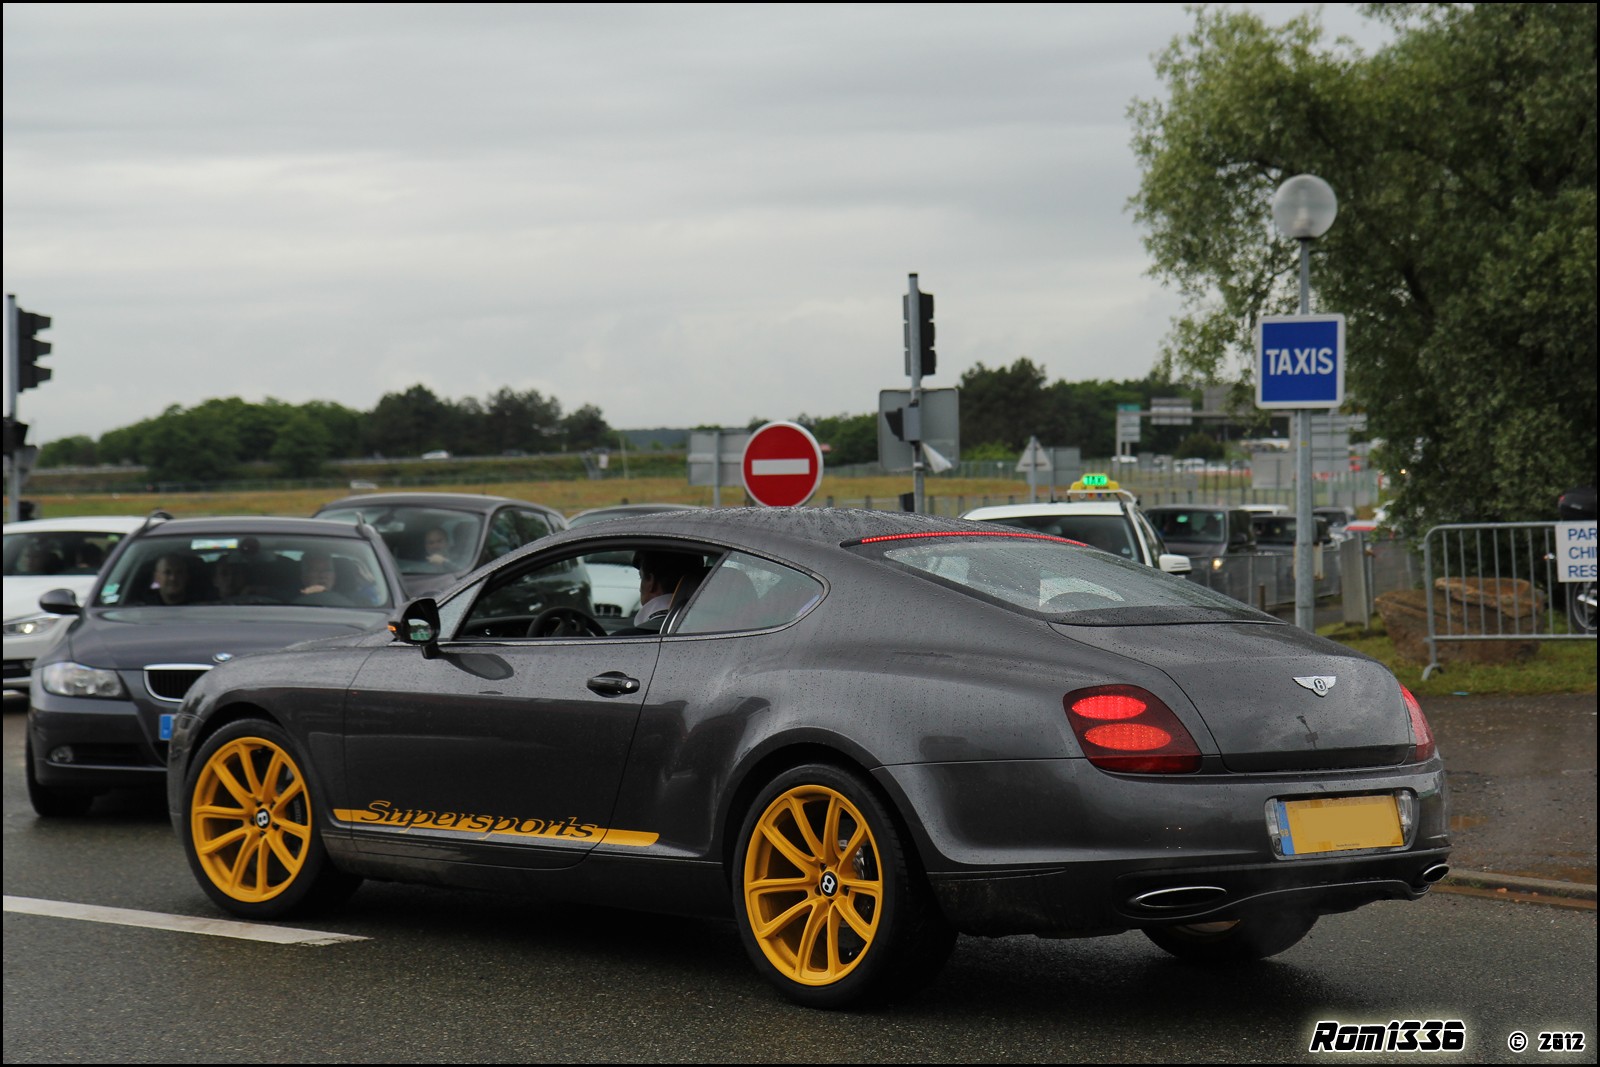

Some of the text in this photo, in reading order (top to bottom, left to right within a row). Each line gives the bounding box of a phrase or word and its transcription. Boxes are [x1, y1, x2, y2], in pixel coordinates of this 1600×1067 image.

[1265, 347, 1334, 376] TAXIS
[1568, 546, 1597, 559] CHI
[1568, 565, 1597, 578] RES
[361, 800, 598, 841] Supersports
